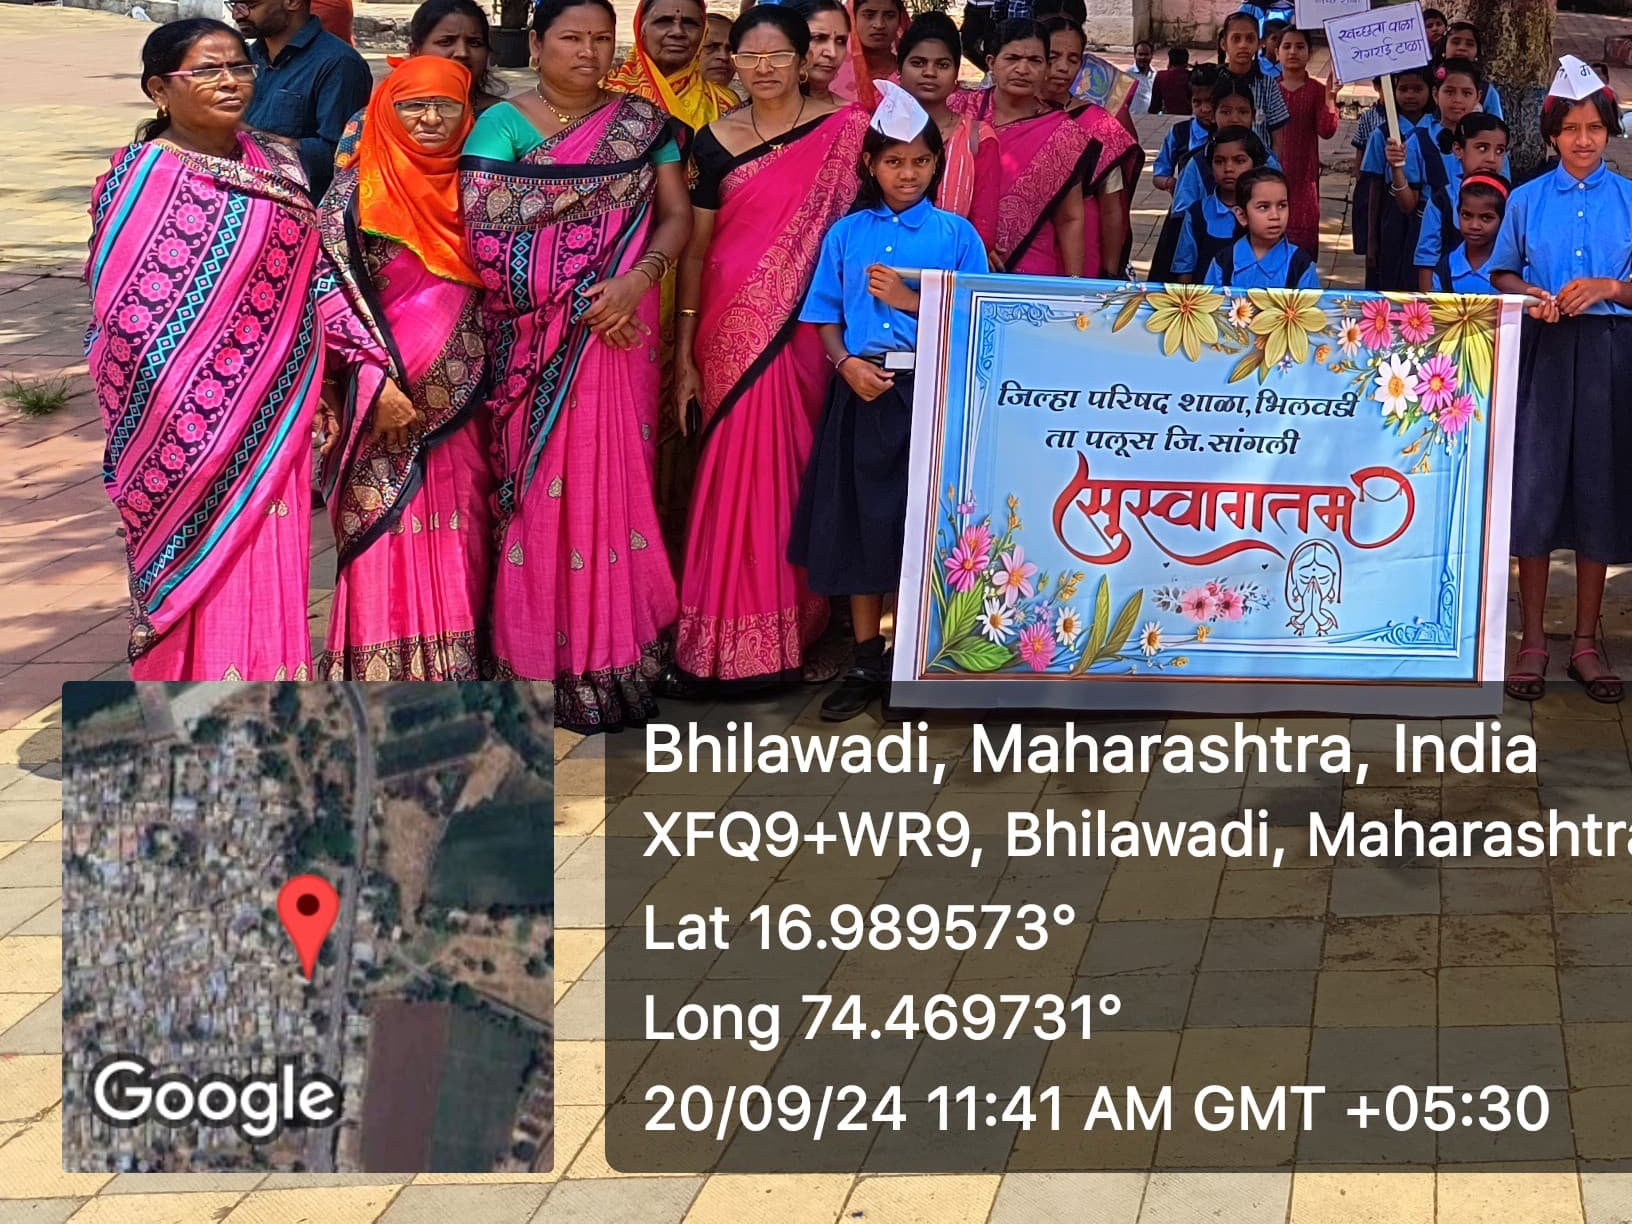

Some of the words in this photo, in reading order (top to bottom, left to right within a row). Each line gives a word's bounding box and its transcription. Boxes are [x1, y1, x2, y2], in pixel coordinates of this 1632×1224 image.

[1351, 37, 1397, 64] रोगराई
[998, 380, 1082, 410] जिल्हा
[1088, 384, 1172, 415] परिषद
[1045, 429, 1077, 449] ता
[1085, 430, 1159, 458] पलूस
